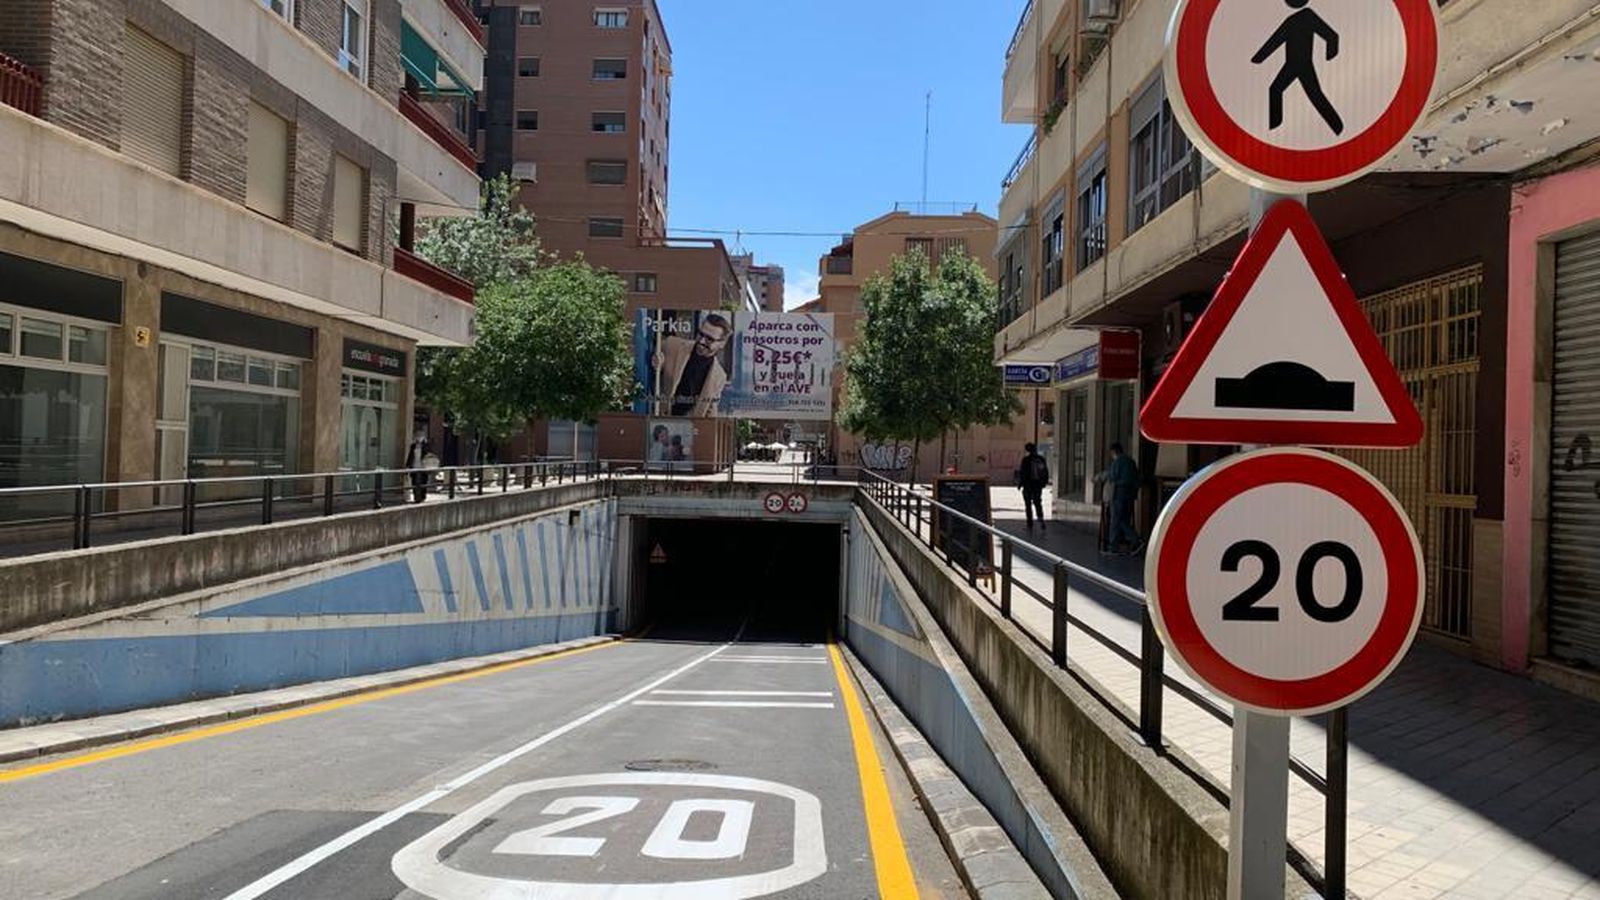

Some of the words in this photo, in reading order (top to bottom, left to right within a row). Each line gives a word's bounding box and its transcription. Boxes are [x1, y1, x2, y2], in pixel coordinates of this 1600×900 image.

[642, 316, 692, 332] Parkia
[749, 320, 793, 333] Aparca
[797, 324, 818, 332] con
[743, 335, 799, 345] nosotros
[802, 336, 824, 347] por
[760, 371, 767, 381] y
[754, 385, 769, 393] en
[773, 383, 783, 393] el
[787, 384, 811, 394] AVE
[768, 498, 782, 507] 20
[1220, 539, 1363, 623] 20
[491, 796, 755, 860] 20
